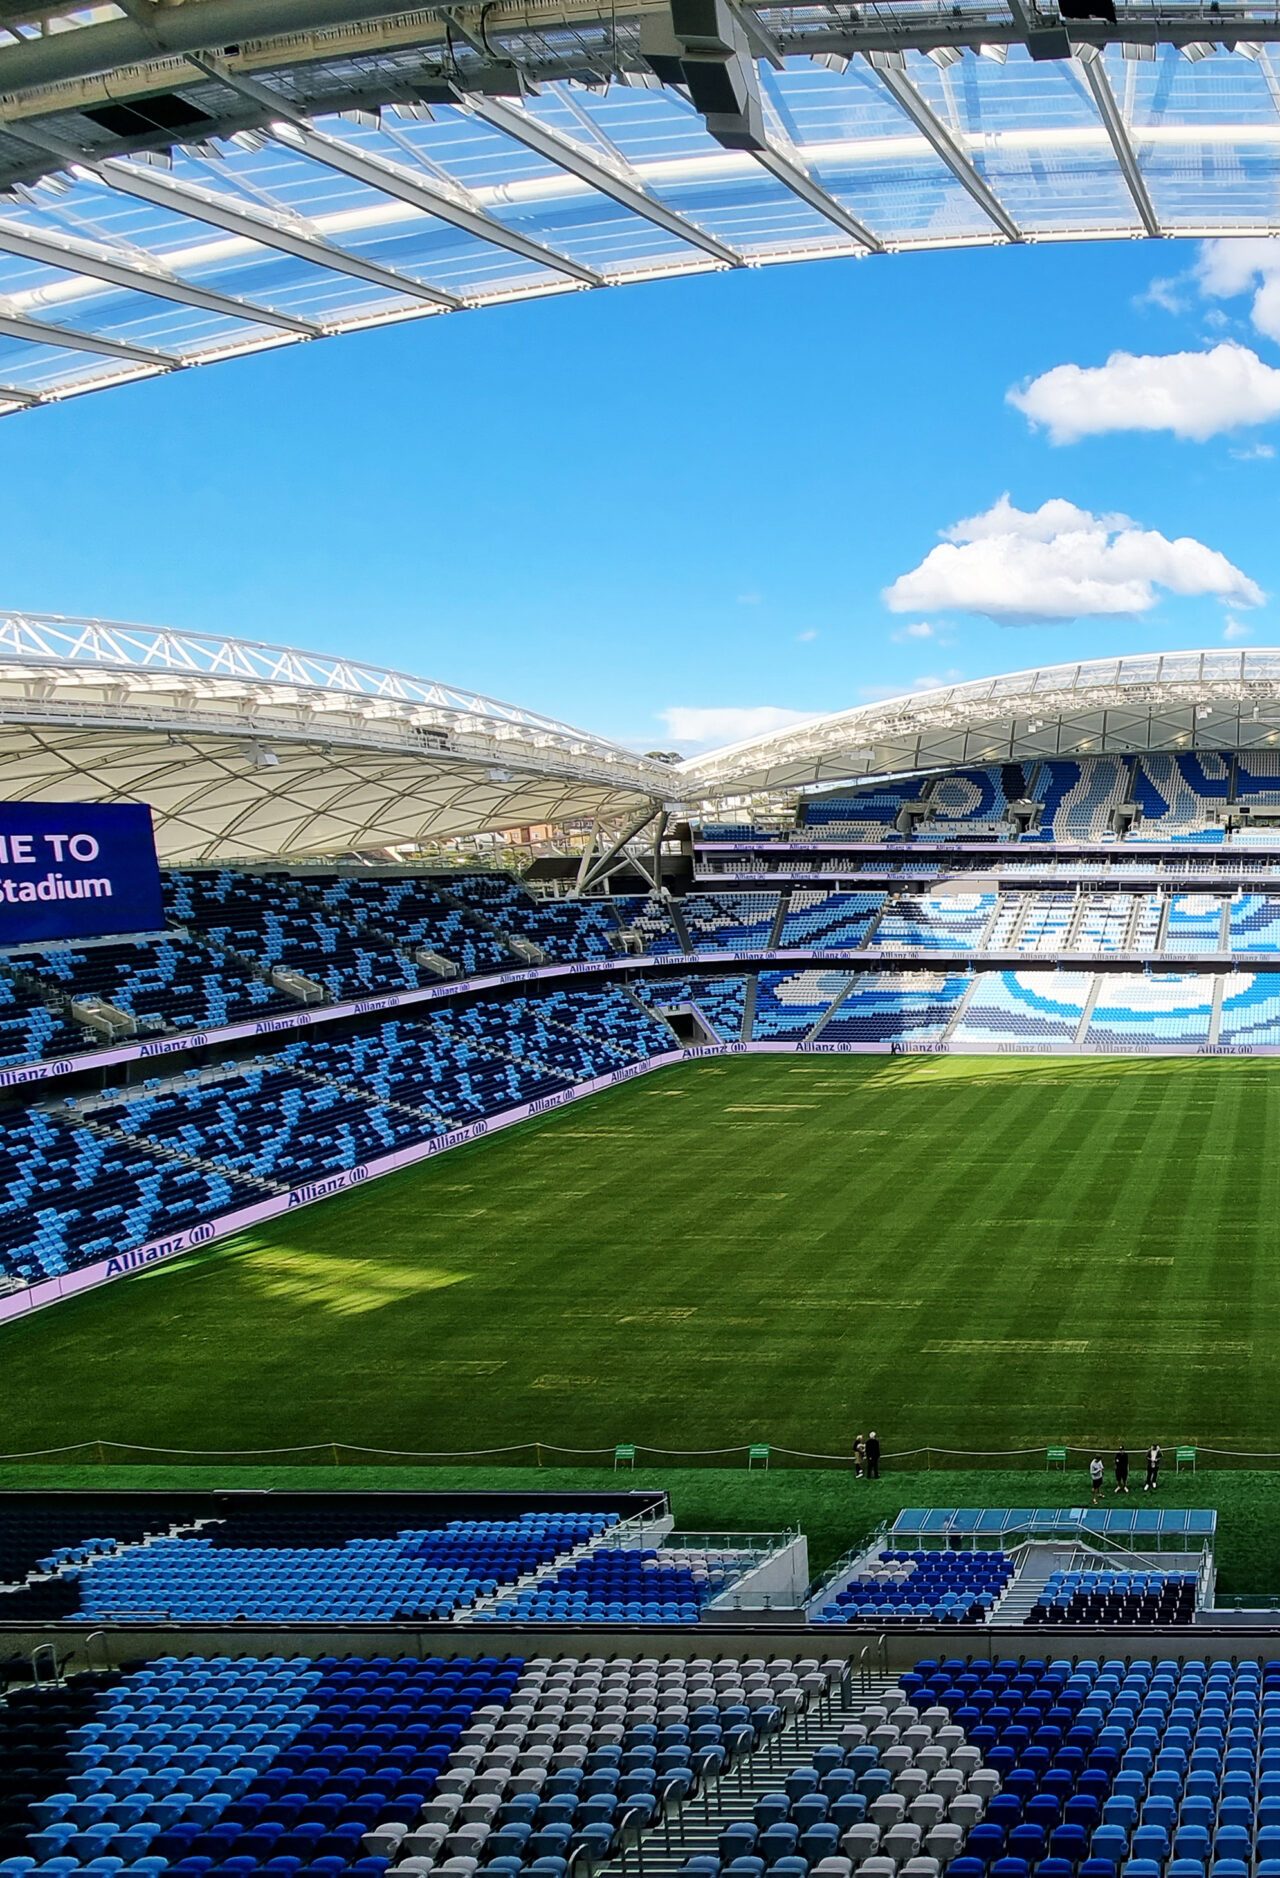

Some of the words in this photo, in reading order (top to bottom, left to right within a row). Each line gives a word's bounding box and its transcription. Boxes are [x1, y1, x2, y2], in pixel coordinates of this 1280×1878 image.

[44, 834, 99, 862] TO
[0, 873, 113, 903] tadium
[654, 956, 684, 965] Allianz
[734, 952, 763, 960] Allianz
[812, 951, 839, 959] Allianz
[880, 951, 907, 959] Allianz
[569, 963, 601, 973] Allianz
[500, 973, 525, 984] Allianz
[431, 986, 458, 998] Allianz
[354, 1000, 386, 1014] Allianz
[255, 1019, 294, 1034] Allianz
[139, 1038, 187, 1058] Allianz
[682, 1045, 728, 1059] Allianz
[795, 1042, 835, 1052] Allianz
[894, 1042, 932, 1052] Allianz
[997, 1043, 1034, 1052] Allianz
[1094, 1044, 1133, 1053] Allianz
[1196, 1044, 1235, 1054] Allianz
[611, 1068, 637, 1082] Allianz
[528, 1094, 561, 1114] Allianz
[428, 1129, 470, 1153] Allianz
[288, 1177, 345, 1206] Allianz
[106, 1236, 184, 1277] Allianz
